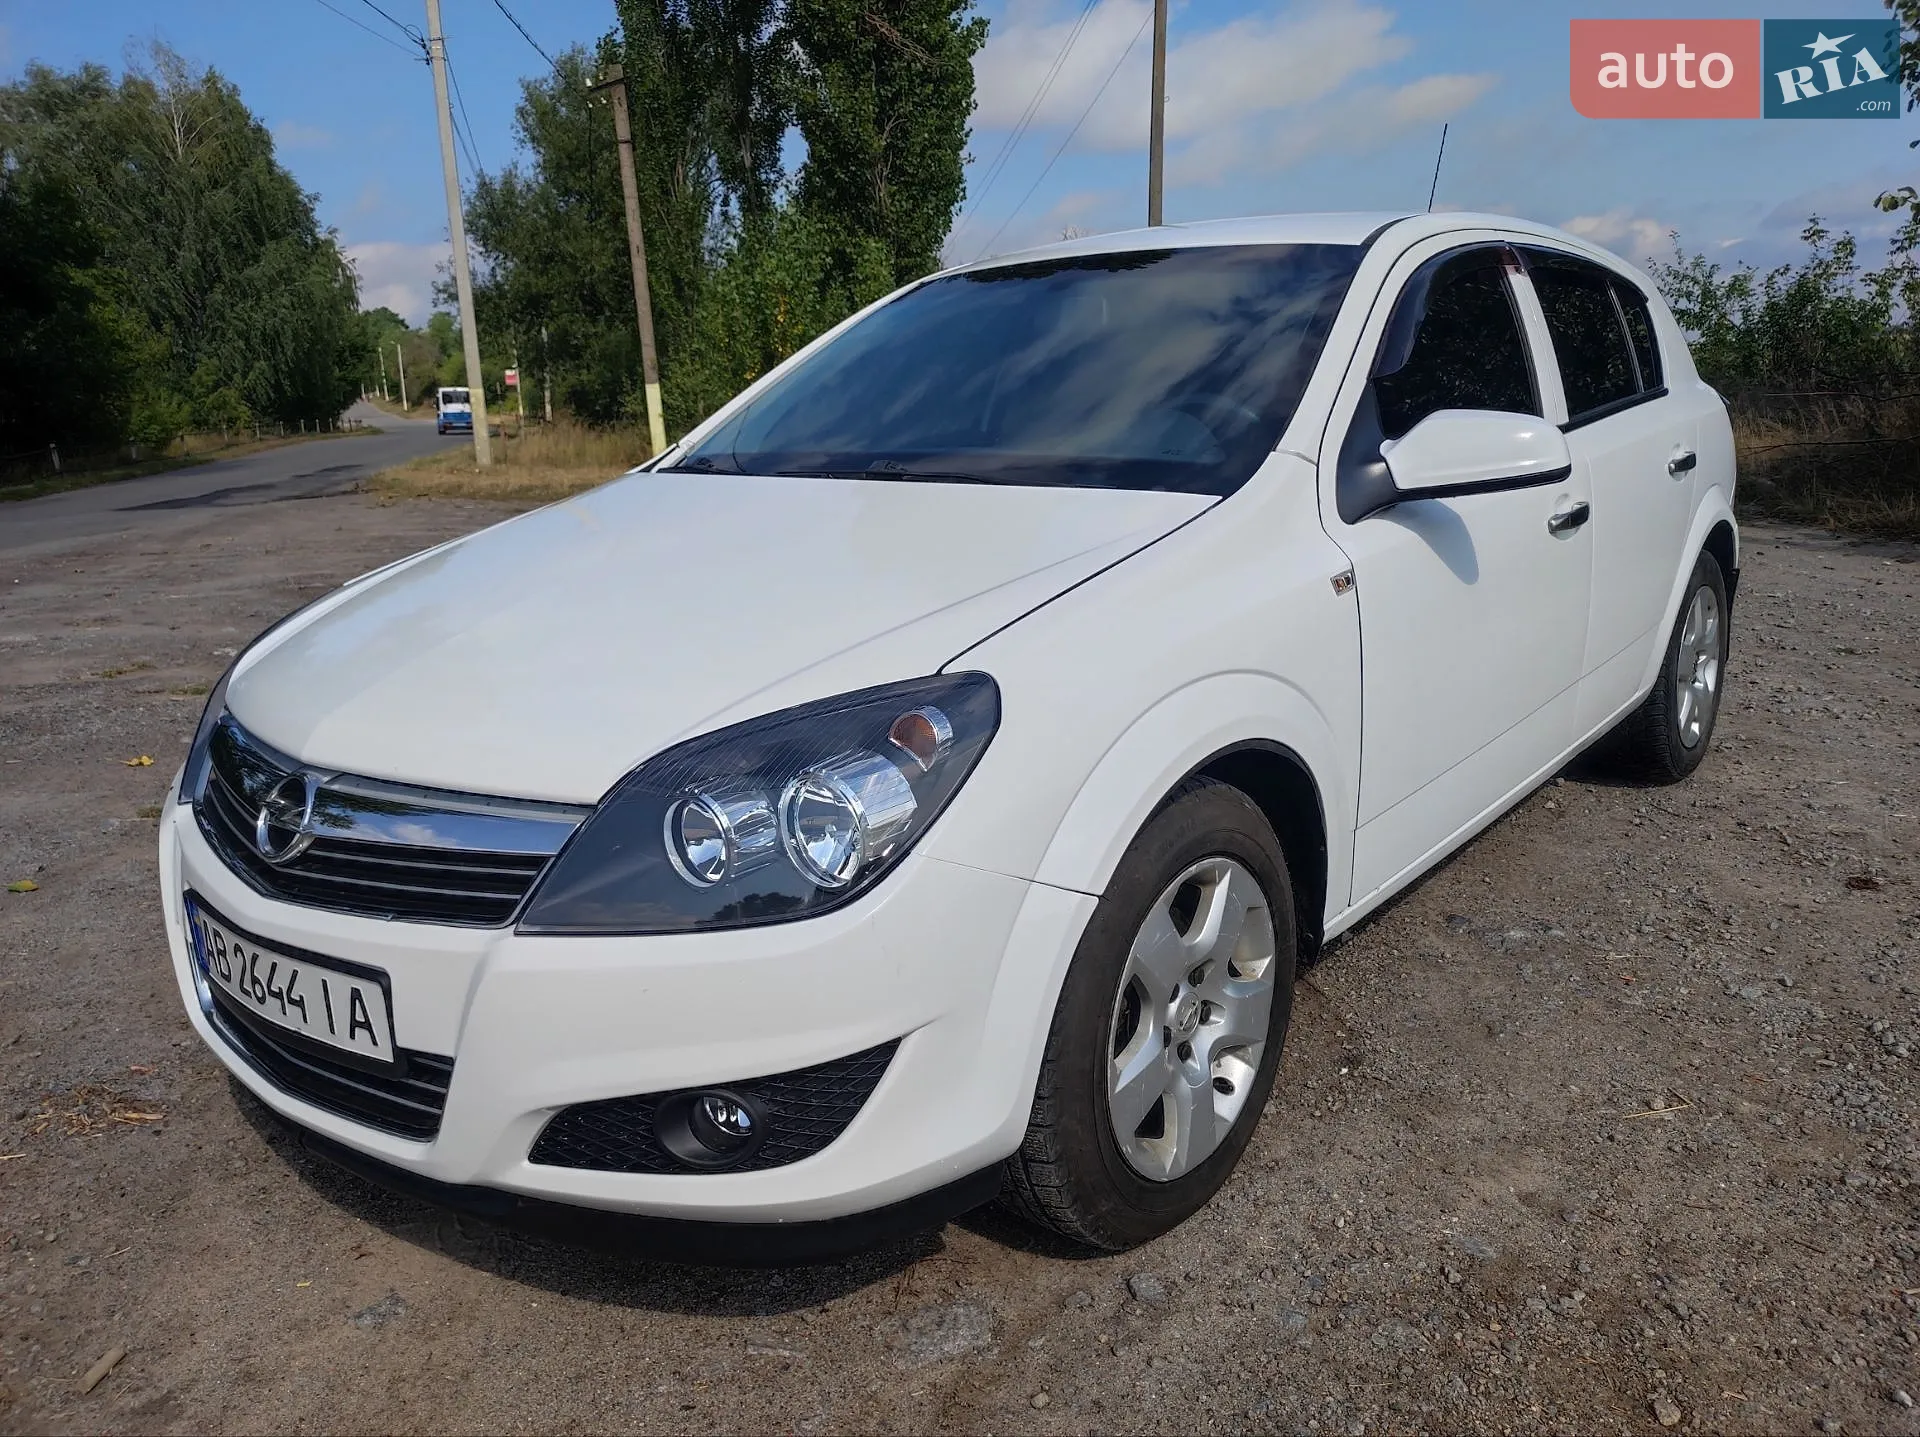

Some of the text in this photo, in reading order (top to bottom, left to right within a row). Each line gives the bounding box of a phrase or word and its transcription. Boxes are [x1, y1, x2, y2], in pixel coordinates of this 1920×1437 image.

[203, 919, 379, 1047] AB 2644 IA
